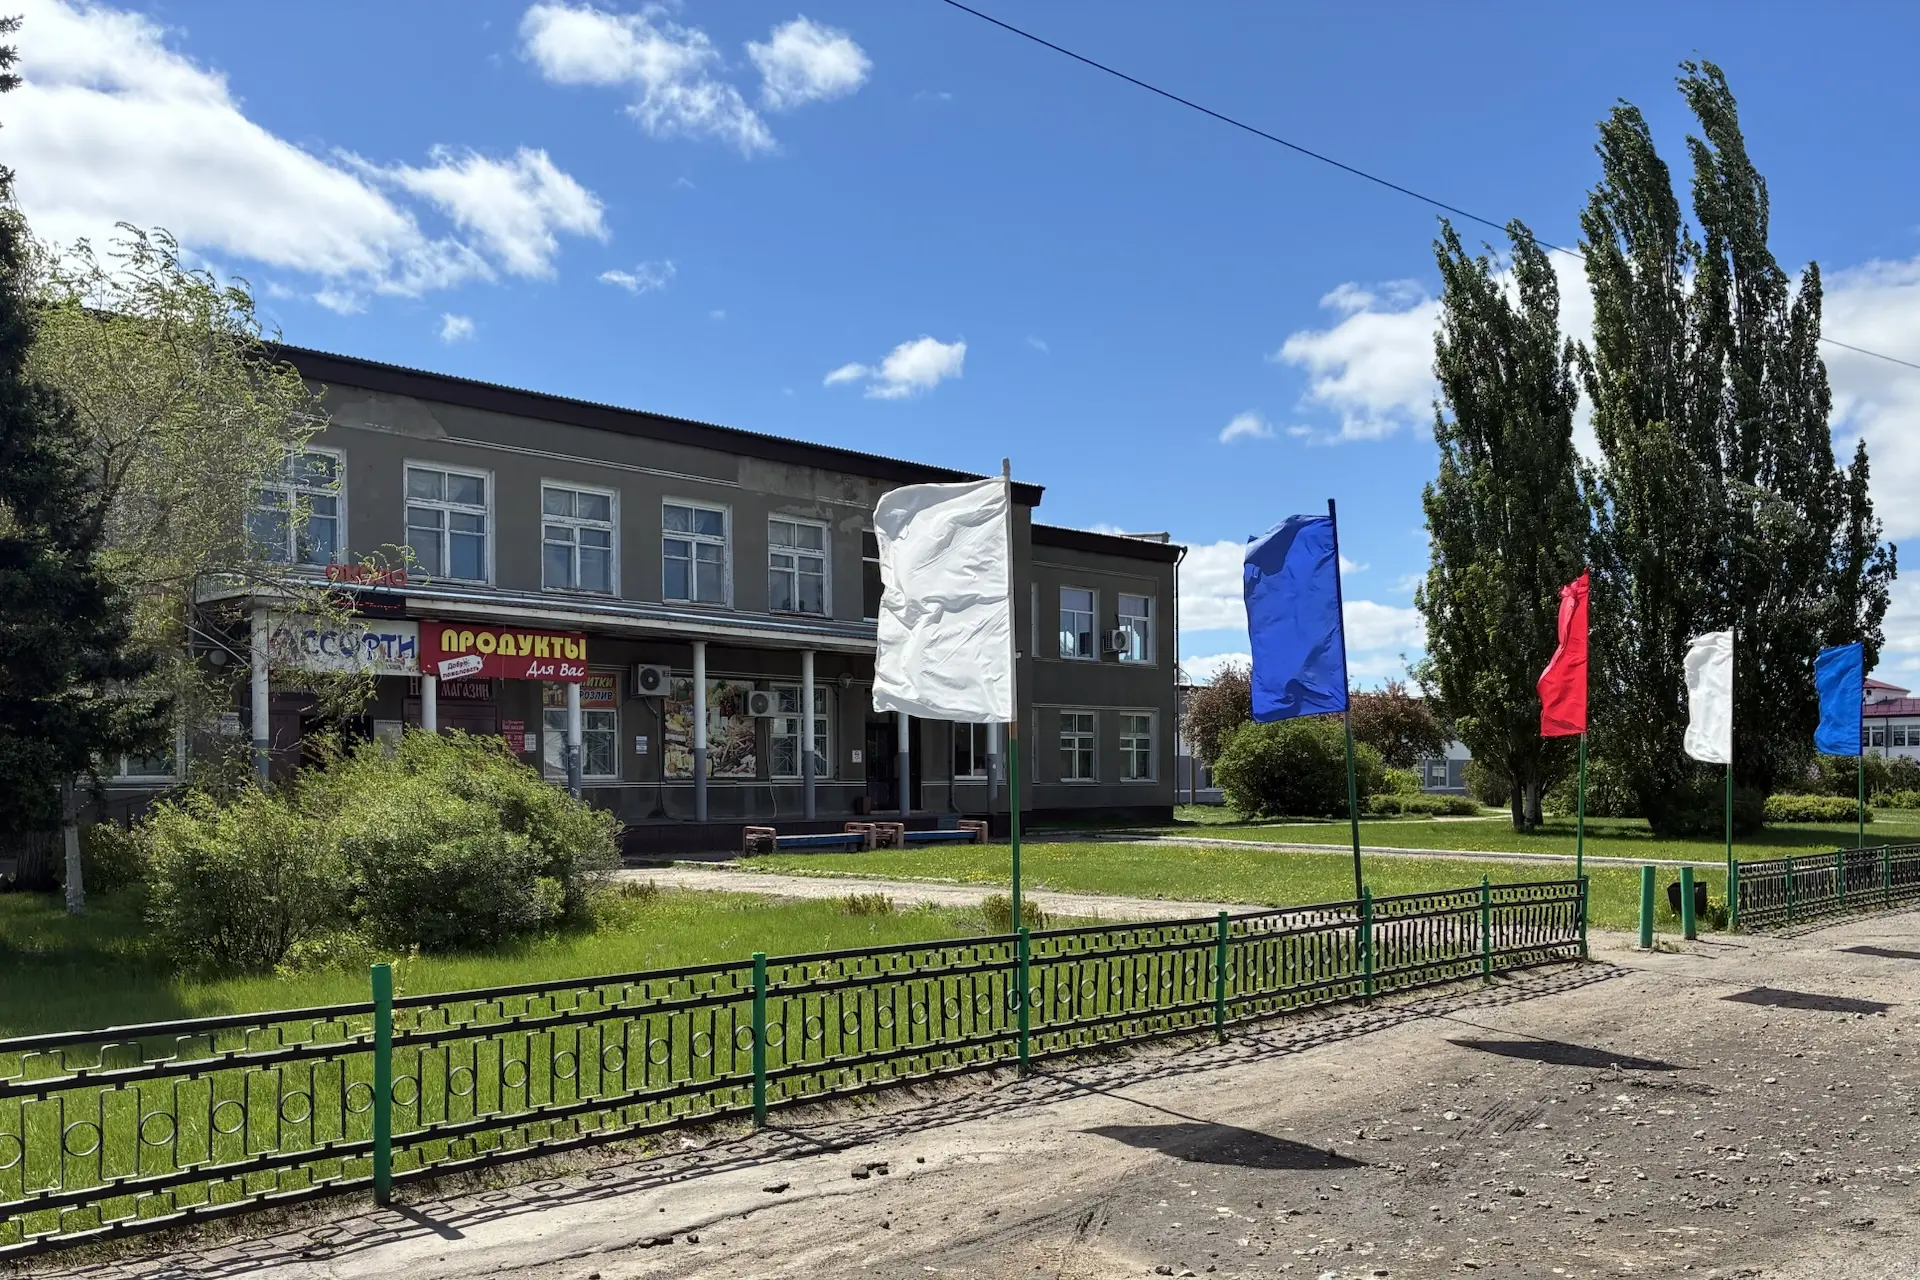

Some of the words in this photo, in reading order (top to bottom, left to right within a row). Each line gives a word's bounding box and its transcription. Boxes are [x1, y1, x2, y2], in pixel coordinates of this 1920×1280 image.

[441, 628, 586, 660] ПРОДУКТЫ
[525, 660, 554, 677] Для
[559, 663, 585, 677] Вас
